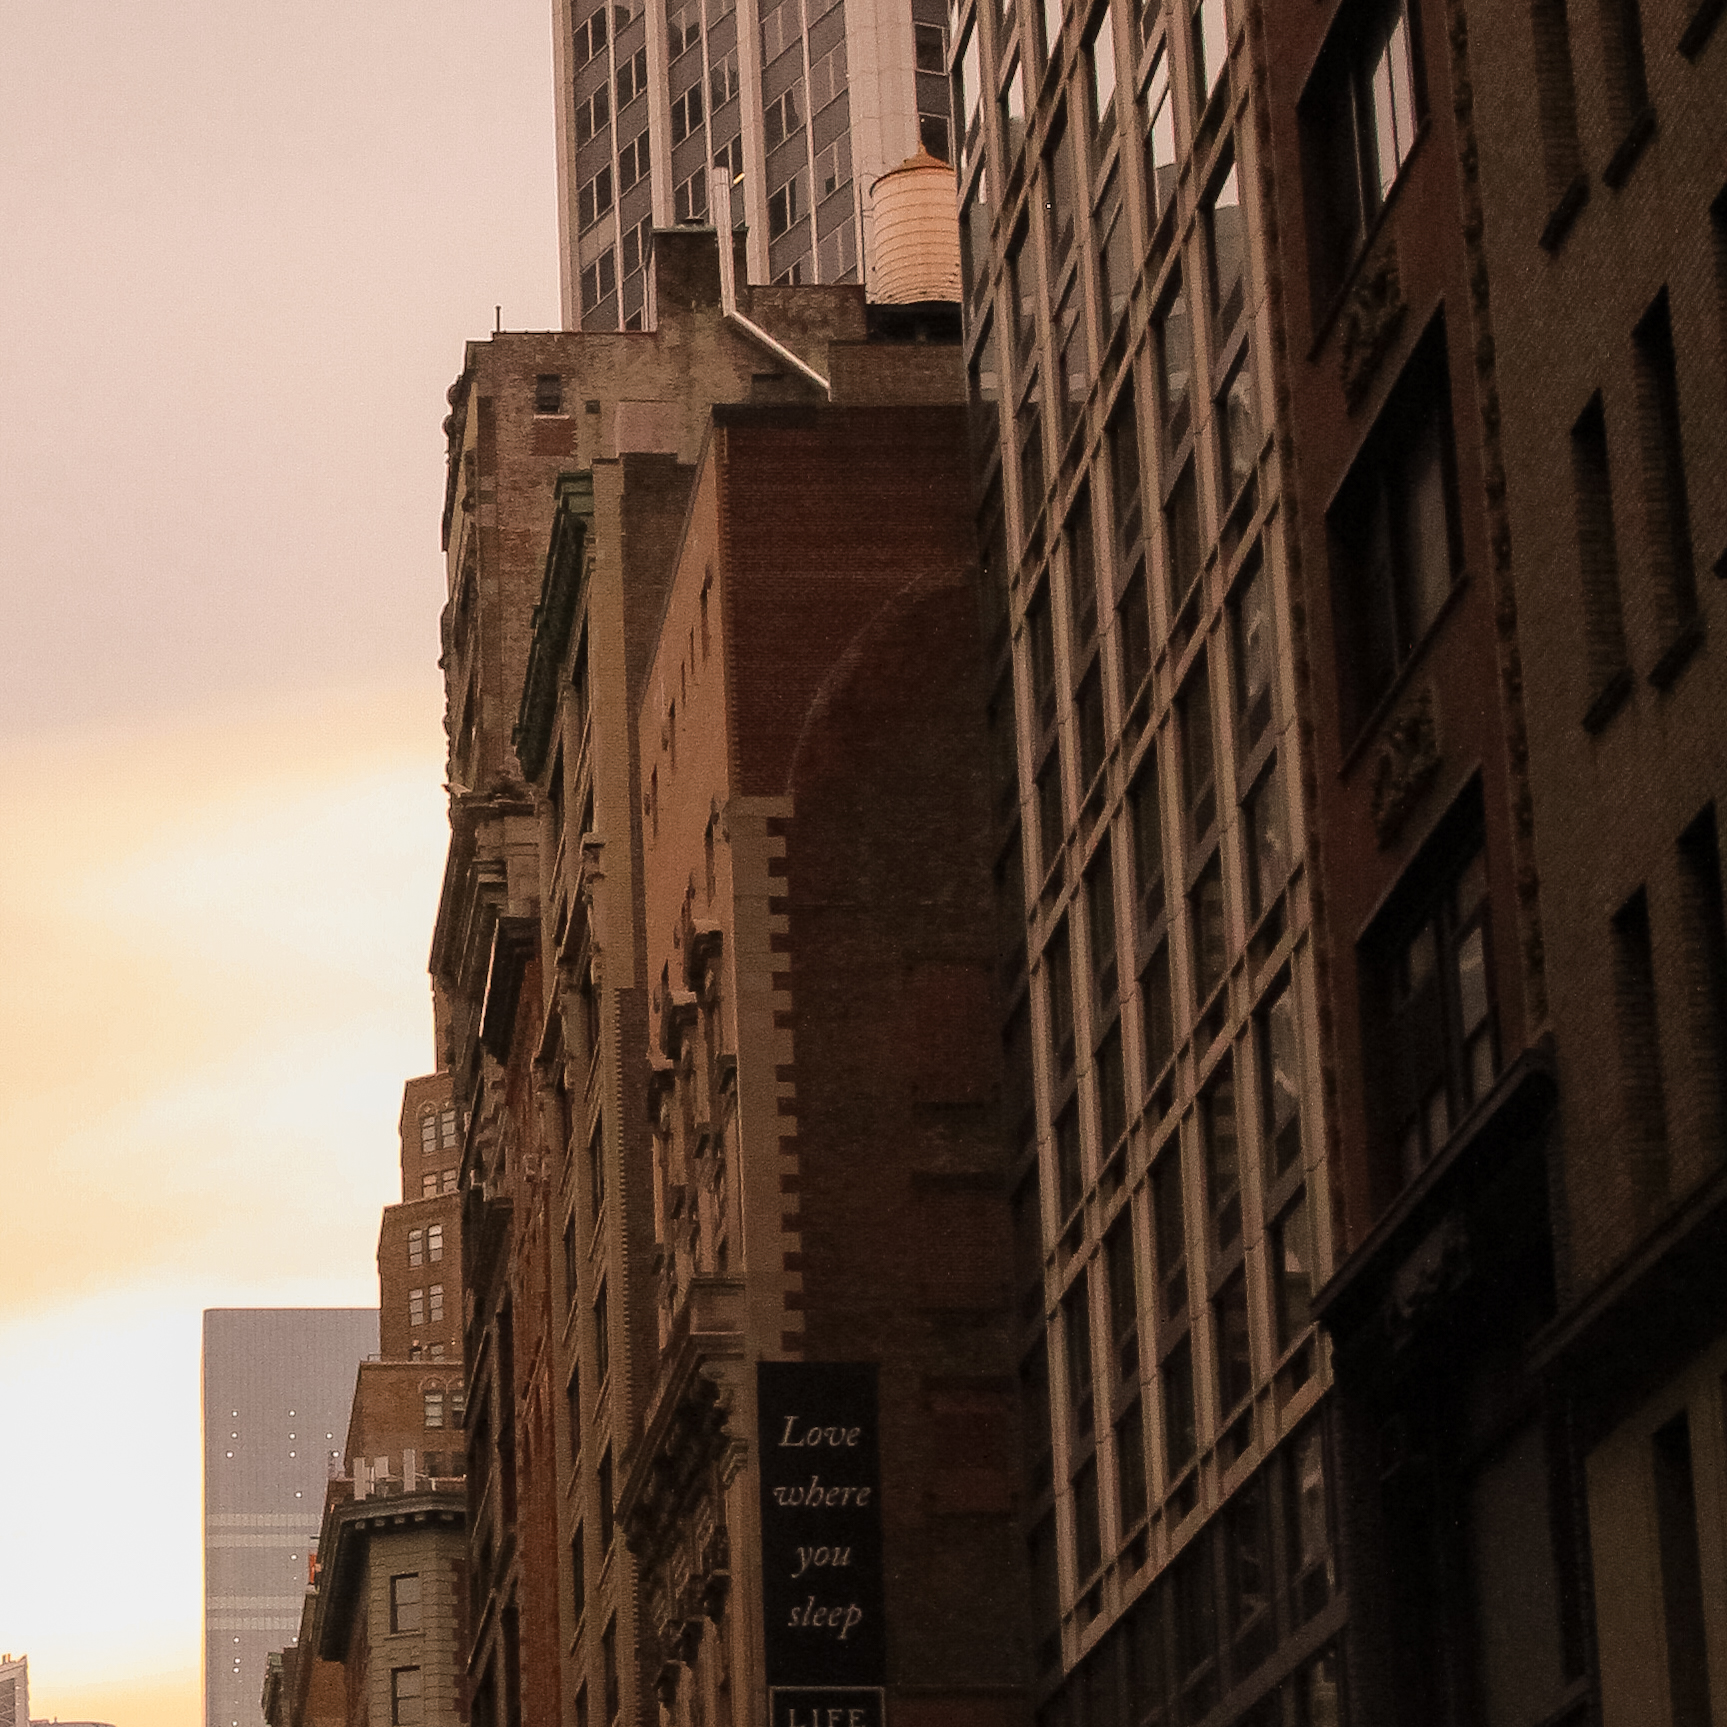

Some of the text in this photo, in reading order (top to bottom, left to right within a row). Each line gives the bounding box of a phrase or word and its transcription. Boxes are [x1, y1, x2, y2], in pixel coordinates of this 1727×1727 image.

[778, 1415, 862, 1447] Love
[773, 1475, 872, 1507] where
[790, 1546, 852, 1579] you
[787, 1595, 863, 1640] sleep
